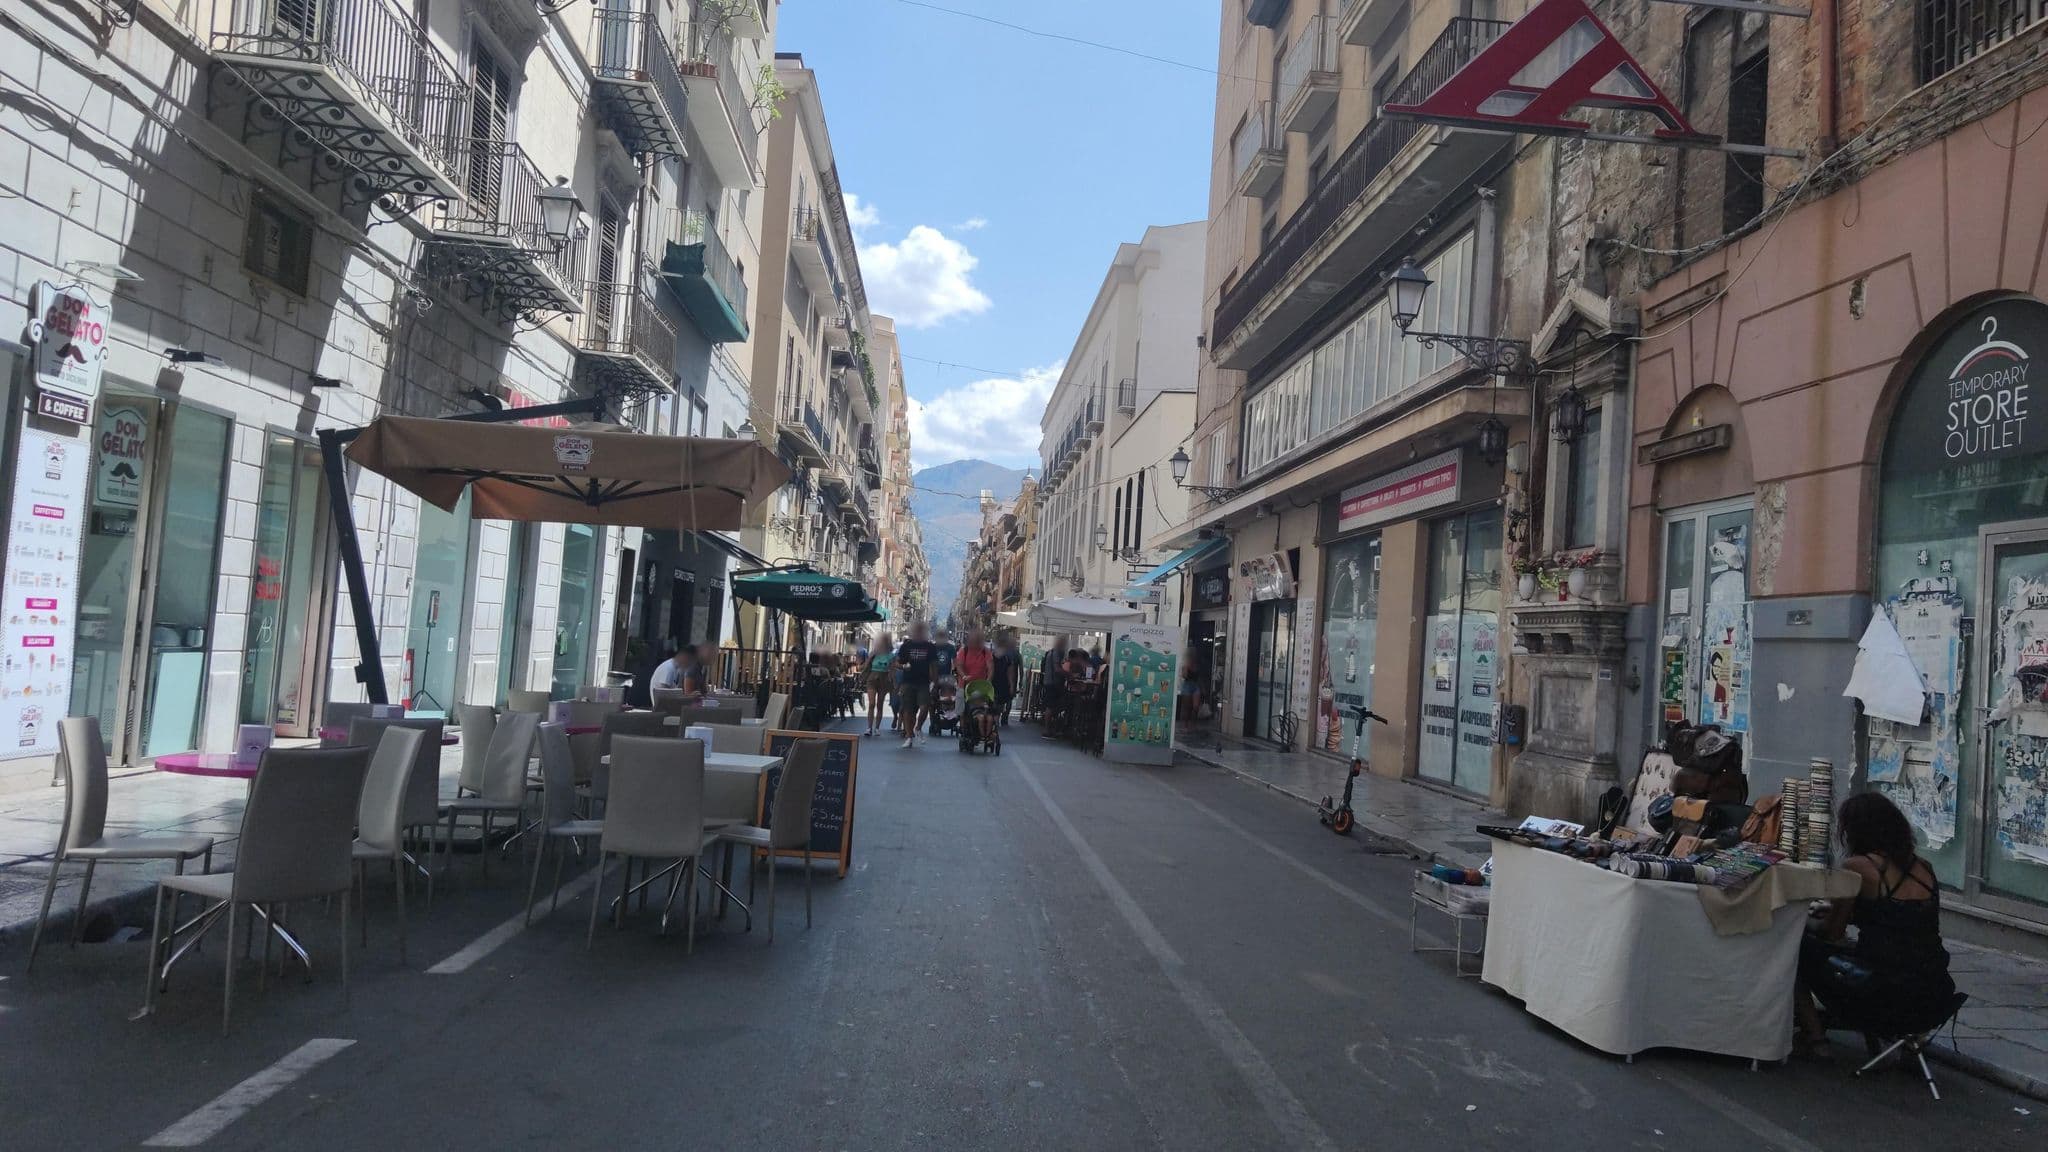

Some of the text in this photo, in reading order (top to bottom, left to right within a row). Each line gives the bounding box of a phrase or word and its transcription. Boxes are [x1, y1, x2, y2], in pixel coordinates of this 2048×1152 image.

[63, 296, 90, 318] DON
[45, 305, 103, 346] GELATO
[1949, 363, 2029, 399] TEMPORARY
[44, 399, 85, 420] & COFFEE
[1947, 385, 2029, 431] STORE
[115, 419, 140, 438] DON
[1945, 417, 2027, 458] OUTLET
[790, 584, 823, 593] PEDRO'S
